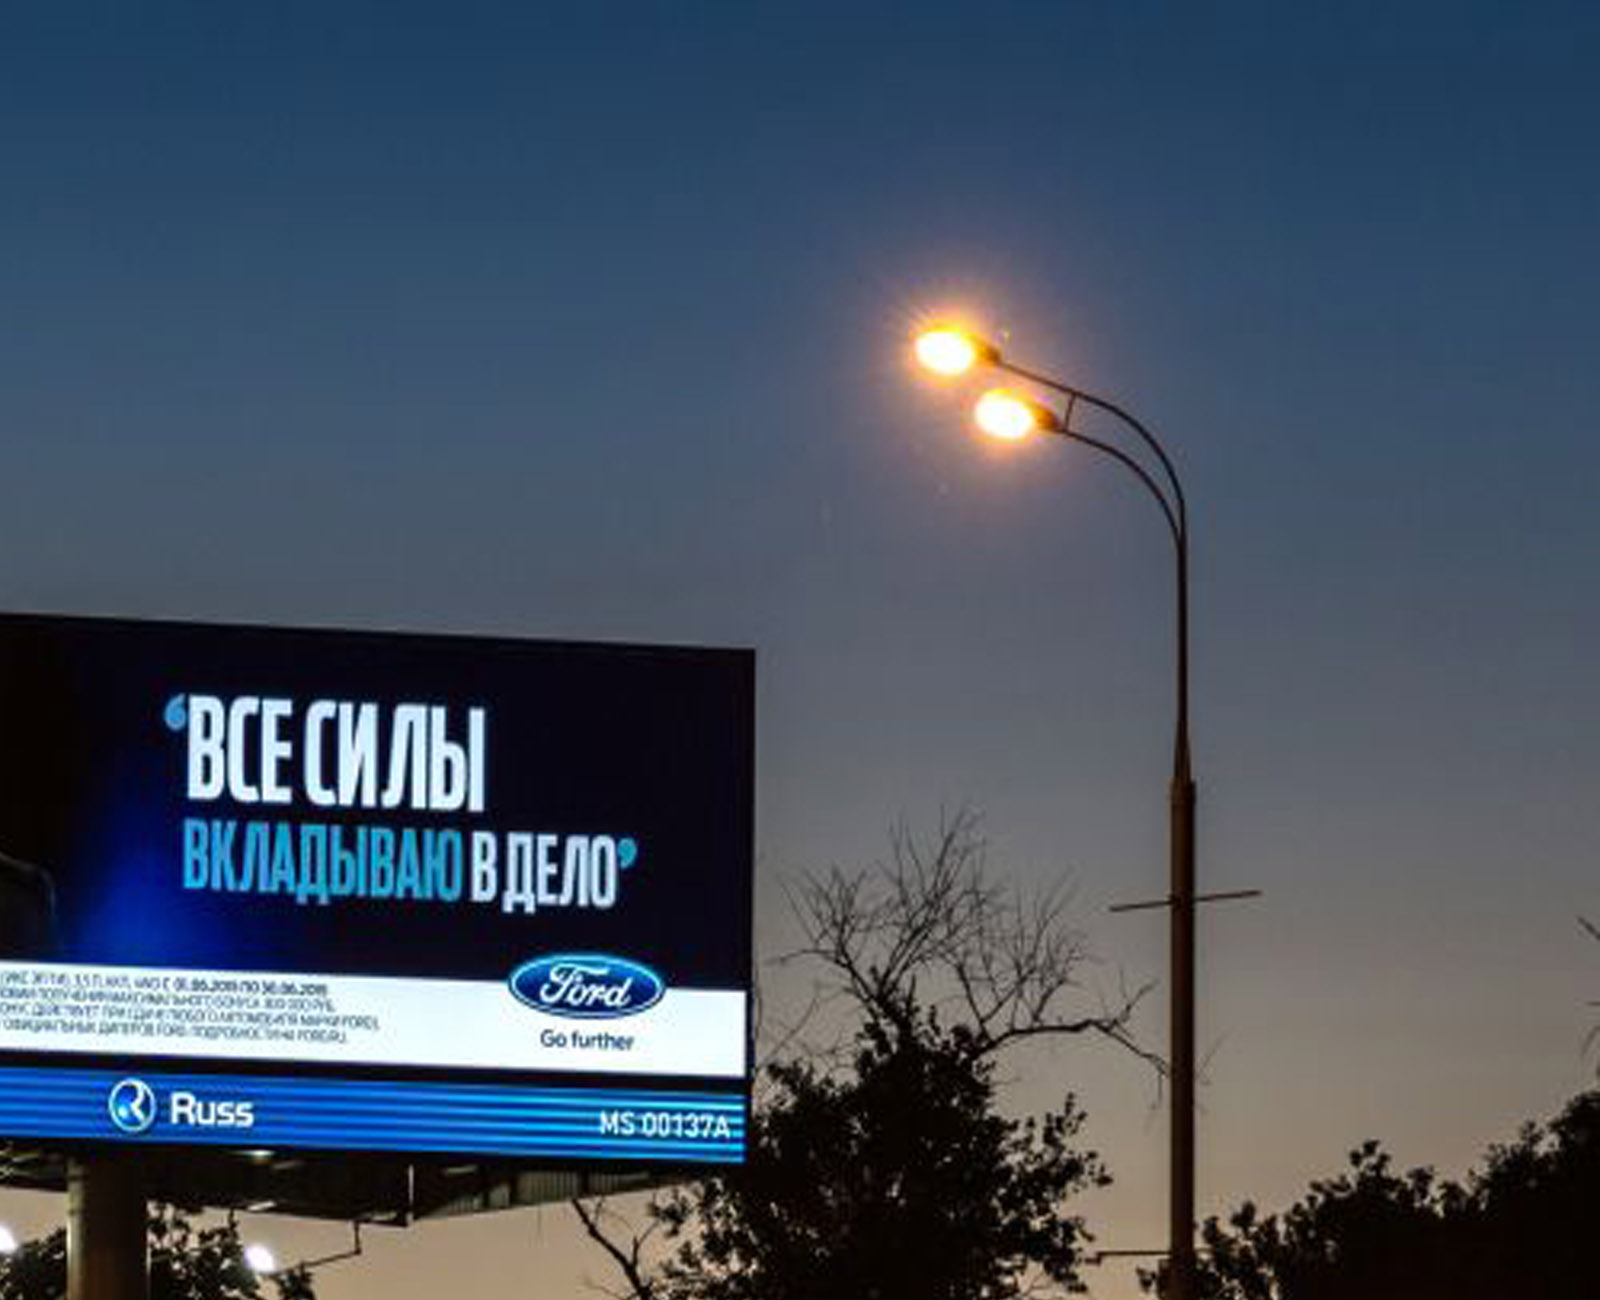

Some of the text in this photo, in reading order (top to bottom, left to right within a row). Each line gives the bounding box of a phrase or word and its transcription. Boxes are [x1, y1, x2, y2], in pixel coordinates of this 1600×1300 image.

[304, 700, 486, 813] СИЛЫ
[183, 818, 463, 906] ВКЛАДЫВАЮ
[471, 830, 498, 903] В
[540, 963, 634, 1007] Ford
[540, 1029, 636, 1051] Go further
[170, 1091, 255, 1128] Russ
[600, 1110, 731, 1139] MS 00137A
